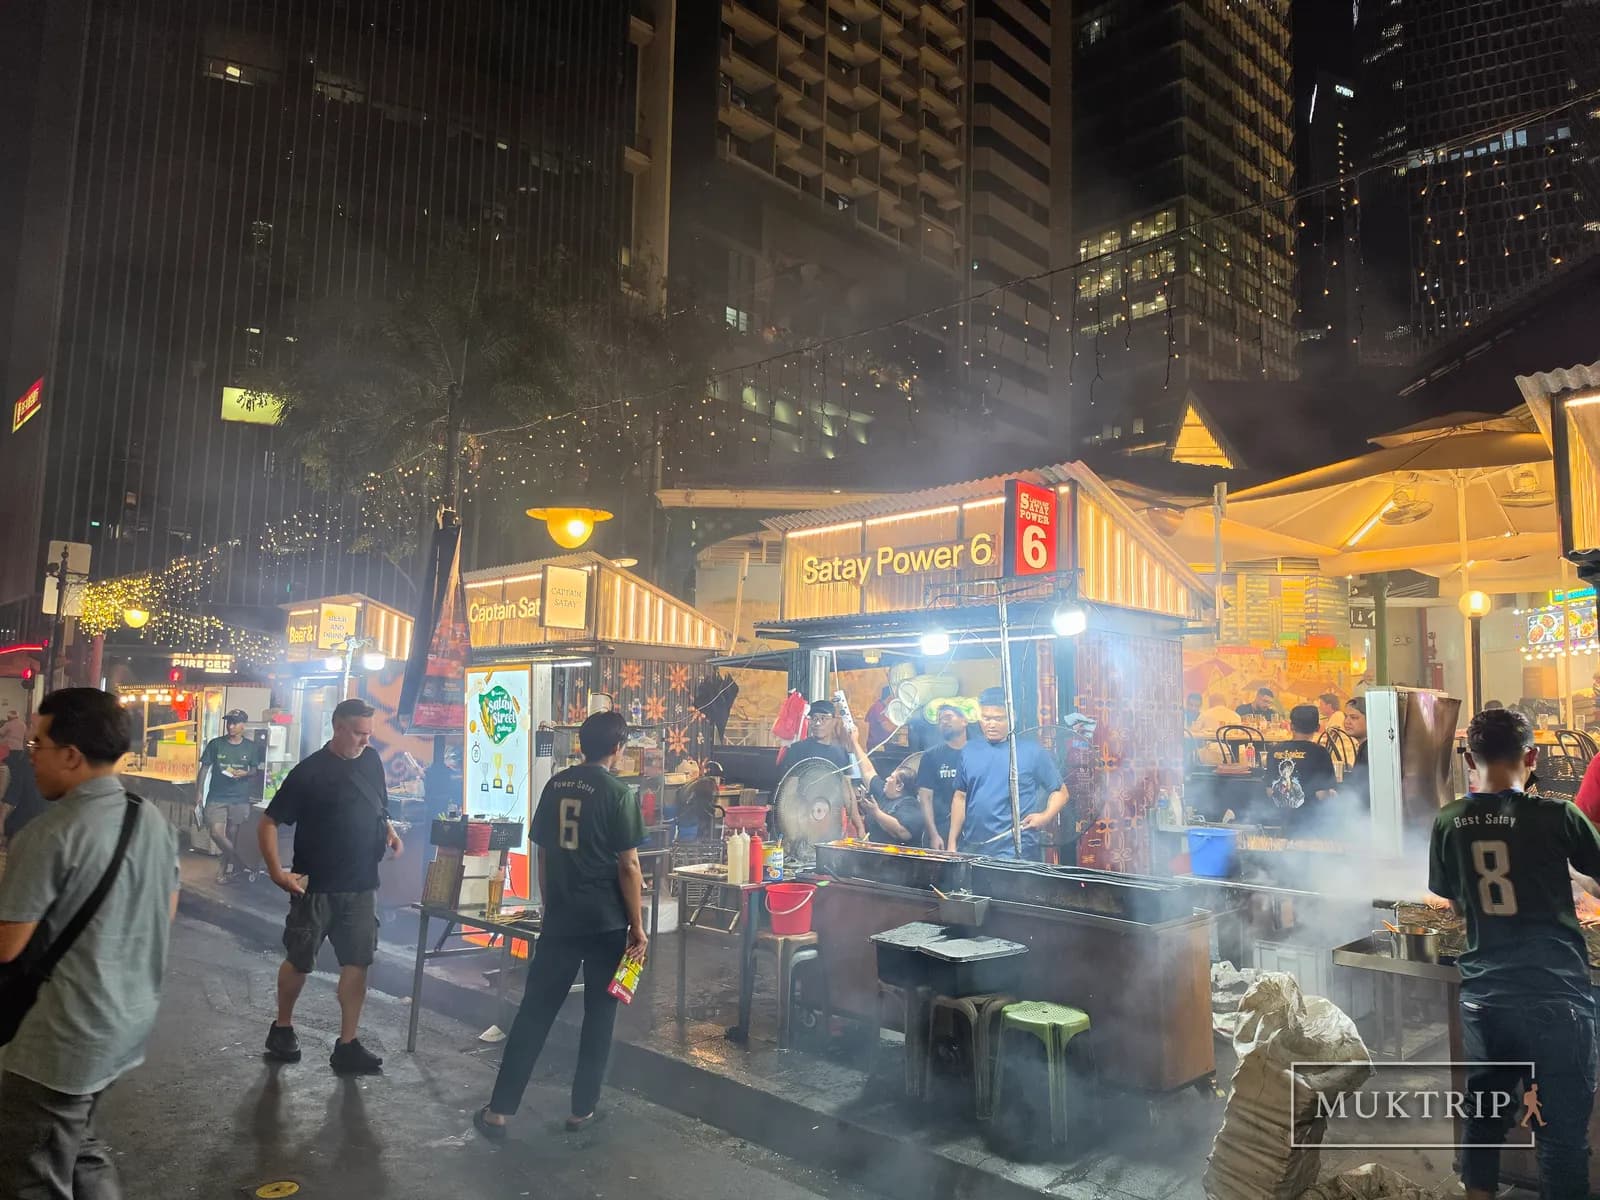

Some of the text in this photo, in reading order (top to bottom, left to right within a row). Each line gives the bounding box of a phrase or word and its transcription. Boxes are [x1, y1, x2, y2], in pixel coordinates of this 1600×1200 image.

[1020, 492, 1050, 515] SATAY
[1020, 509, 1050, 526] POWER
[803, 532, 992, 585] Satay Power 6
[1023, 525, 1048, 569] 6
[469, 600, 516, 626] Captain
[560, 798, 582, 850] 6
[1454, 813, 1517, 829] Best Satay
[1471, 840, 1518, 916] 8
